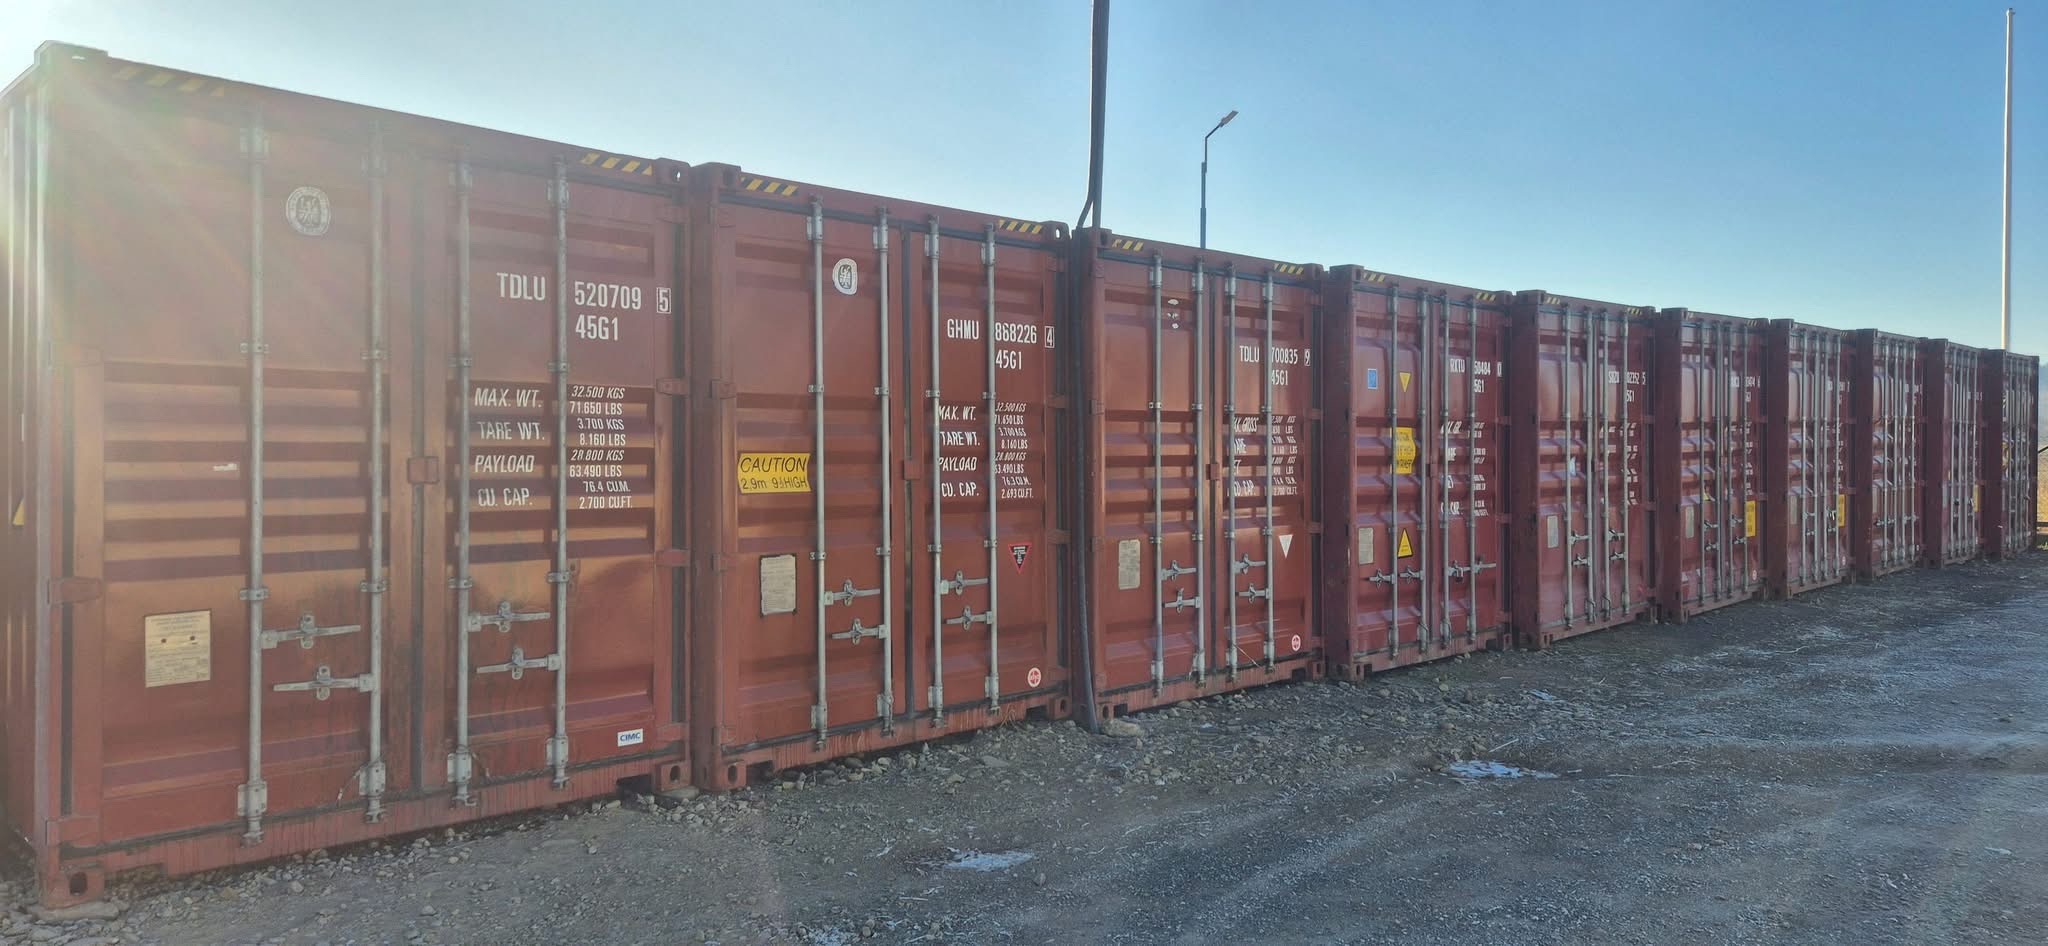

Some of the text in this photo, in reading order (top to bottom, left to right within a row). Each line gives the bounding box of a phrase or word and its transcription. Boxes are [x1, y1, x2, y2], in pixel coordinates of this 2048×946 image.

[496, 272, 671, 313] TDLU 520709 5
[575, 314, 618, 341] 45G1
[947, 318, 980, 340] GHMU
[1046, 327, 1054, 347] 4
[995, 349, 1021, 370] 45G1
[1239, 345, 1310, 366] TDLU 700835 9
[475, 388, 542, 408] MAX. WT.
[572, 385, 626, 399] 32.500 KGS
[570, 401, 623, 415] 71.650 LBS
[962, 406, 976, 420] WT.
[577, 417, 625, 430] 3.700 KGS
[1013, 415, 1024, 424] LBS
[477, 421, 545, 440] TARE WT.
[580, 433, 626, 446] 8.160 LBS
[940, 431, 980, 446] TARE WT.
[1018, 439, 1028, 449] LBS
[606, 449, 625, 461] KGS
[475, 454, 534, 473] PAYLOAD
[570, 464, 622, 477] 63.490 LBS
[740, 457, 807, 473] CAUTION
[938, 456, 978, 471] PAYLOAD
[1013, 463, 1024, 474] LBS
[582, 480, 604, 492] 76.4
[740, 477, 767, 489] 2.9m
[941, 481, 979, 497] CU. CAP.
[478, 487, 533, 507] CU. CAP.
[579, 496, 605, 509] 2.700
[620, 732, 641, 741] CIMC
